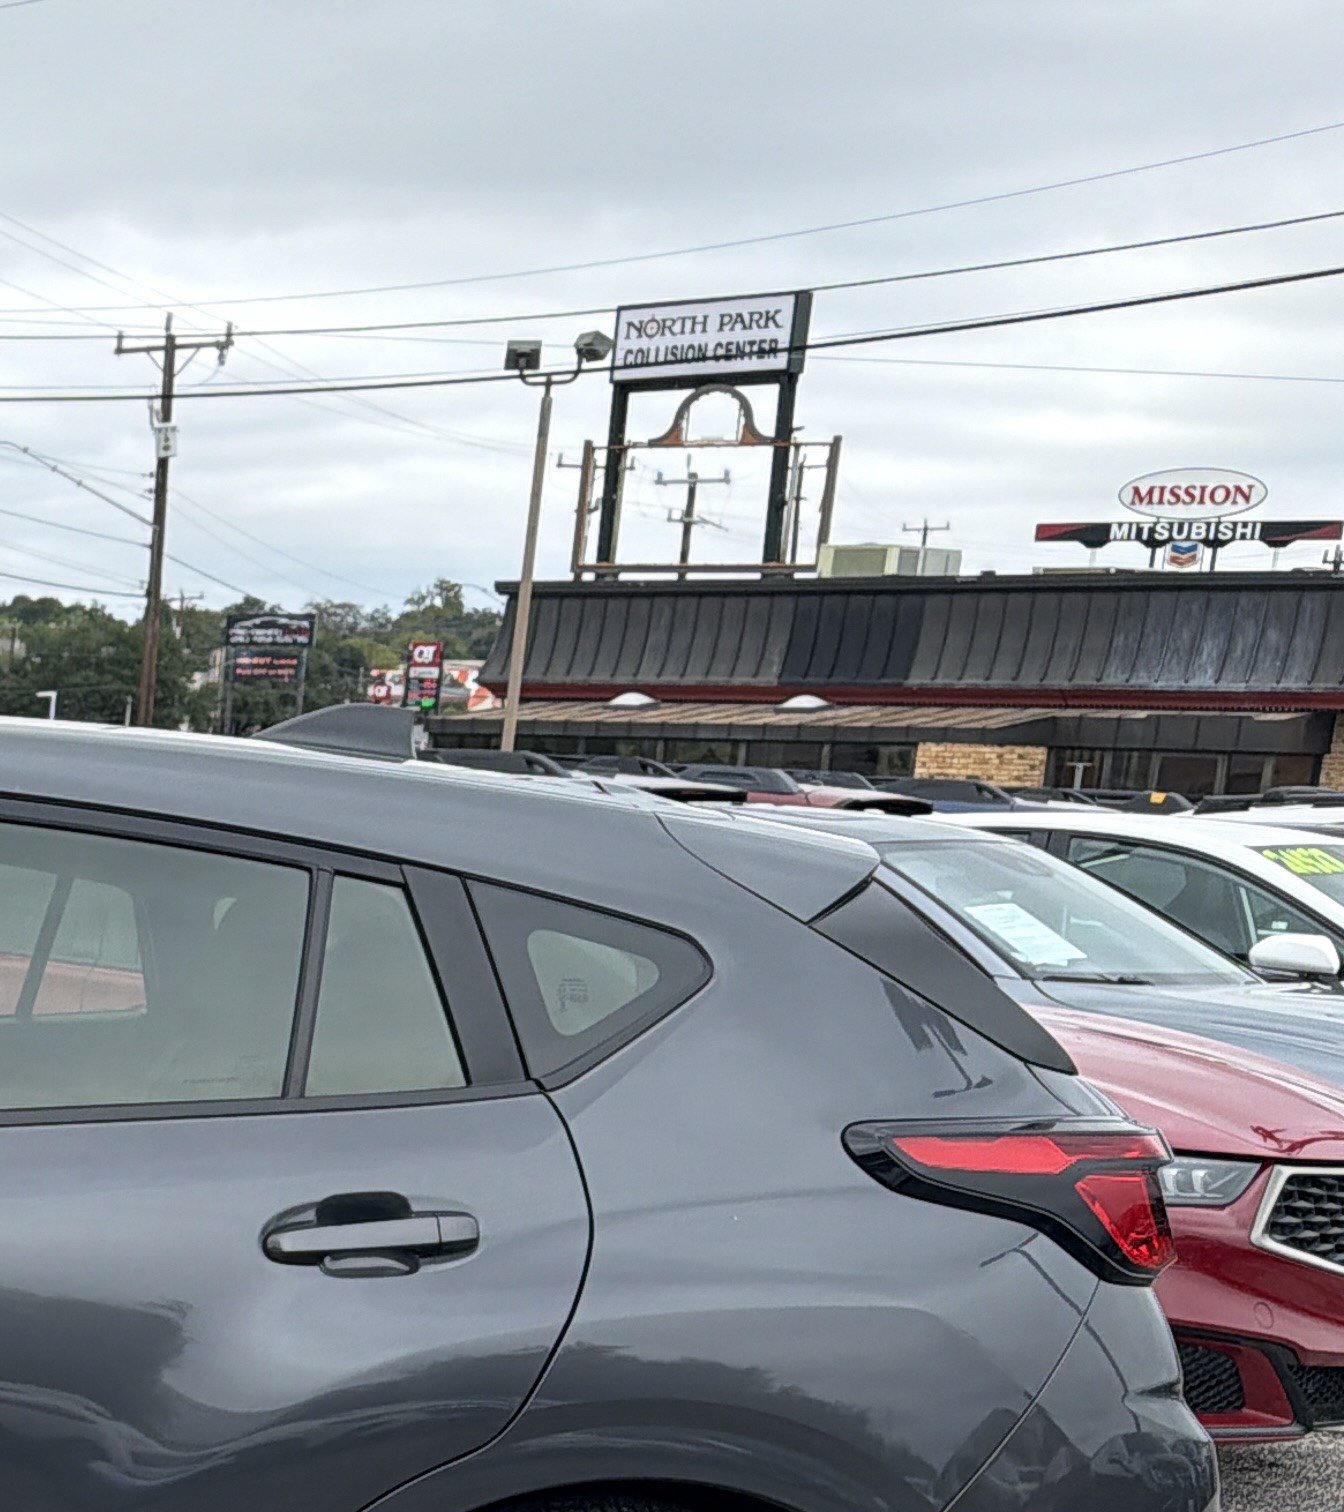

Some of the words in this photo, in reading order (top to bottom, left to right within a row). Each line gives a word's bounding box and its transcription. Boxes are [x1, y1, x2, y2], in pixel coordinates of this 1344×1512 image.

[624, 313, 710, 340] NORTH
[716, 309, 783, 333] PARK
[623, 342, 709, 368] COLLISION
[713, 338, 780, 362] CENTER
[1129, 484, 1255, 507] MISSION
[1109, 522, 1262, 541] MITSUBISHI
